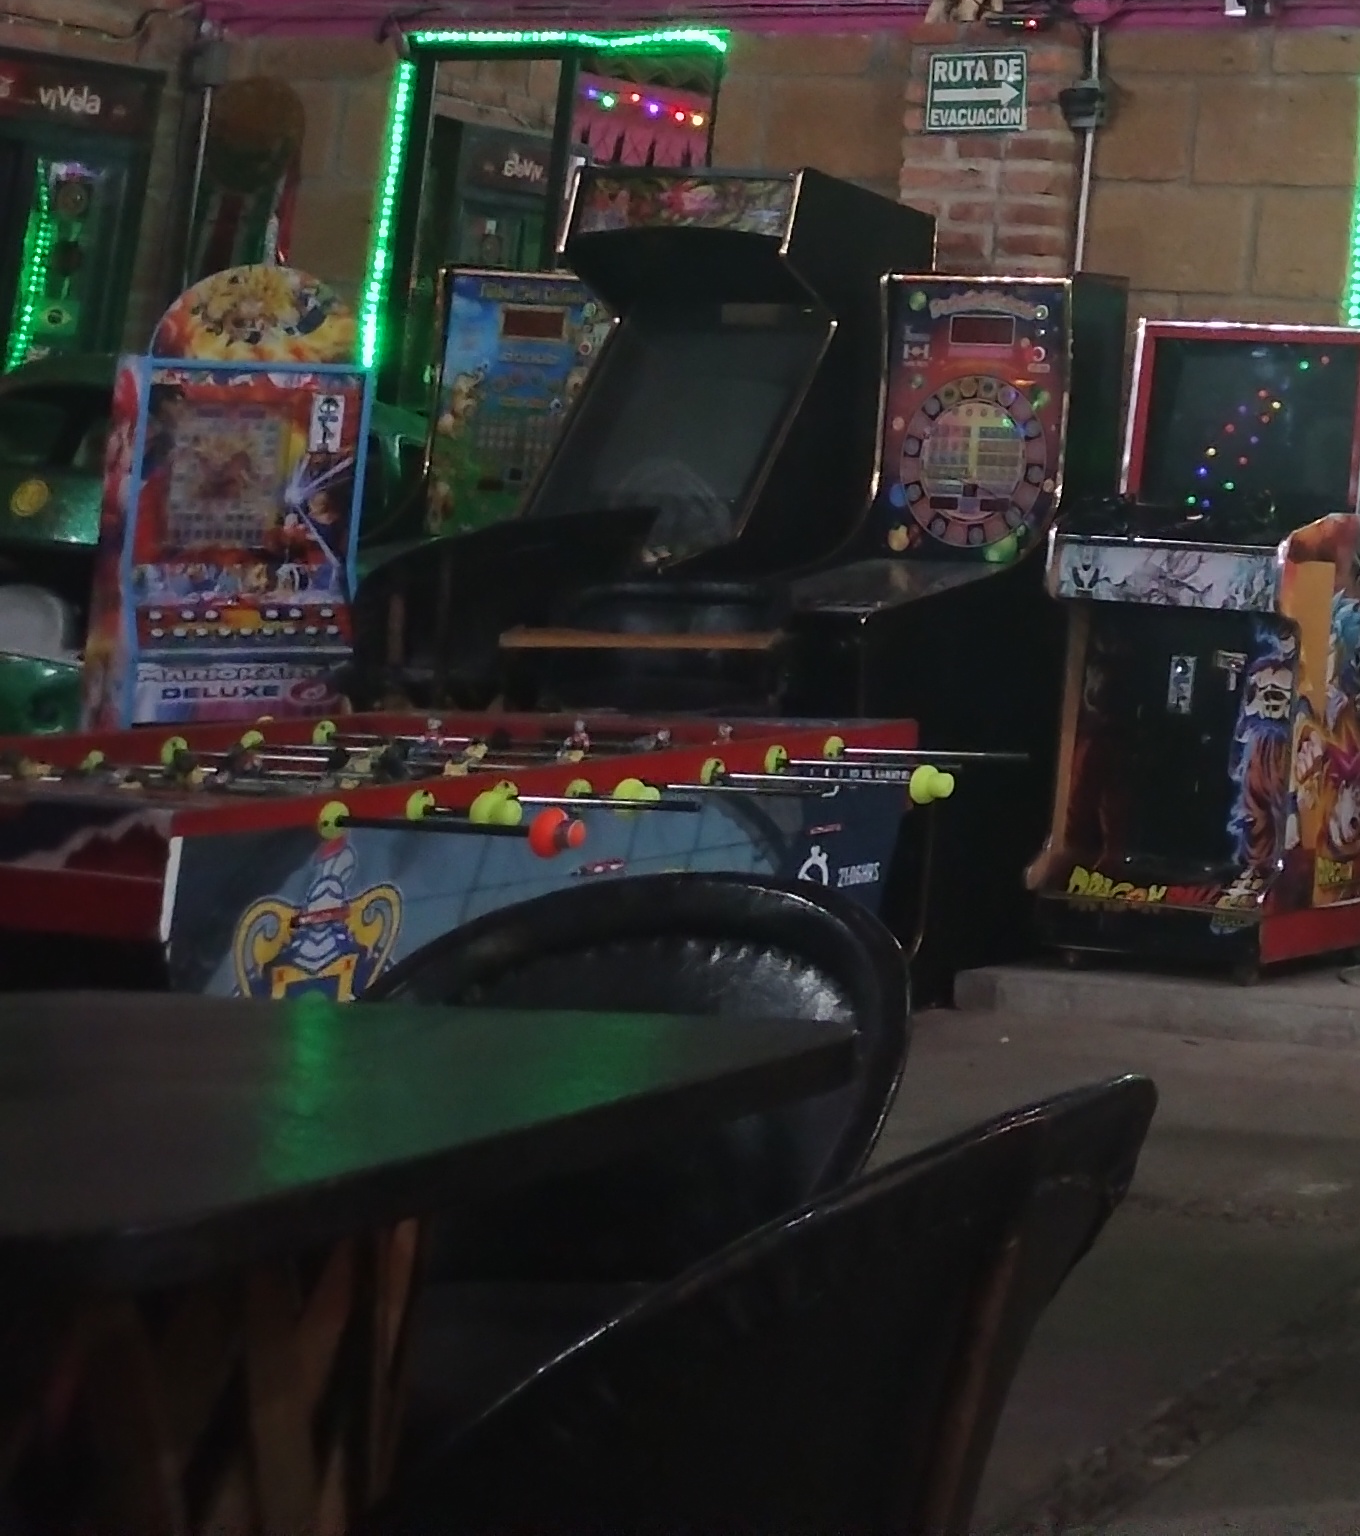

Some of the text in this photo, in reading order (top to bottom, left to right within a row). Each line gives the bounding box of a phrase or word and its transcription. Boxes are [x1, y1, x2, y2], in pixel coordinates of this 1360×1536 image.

[933, 58, 1022, 83] RUTA DE
[161, 685, 280, 700] DELUXE
